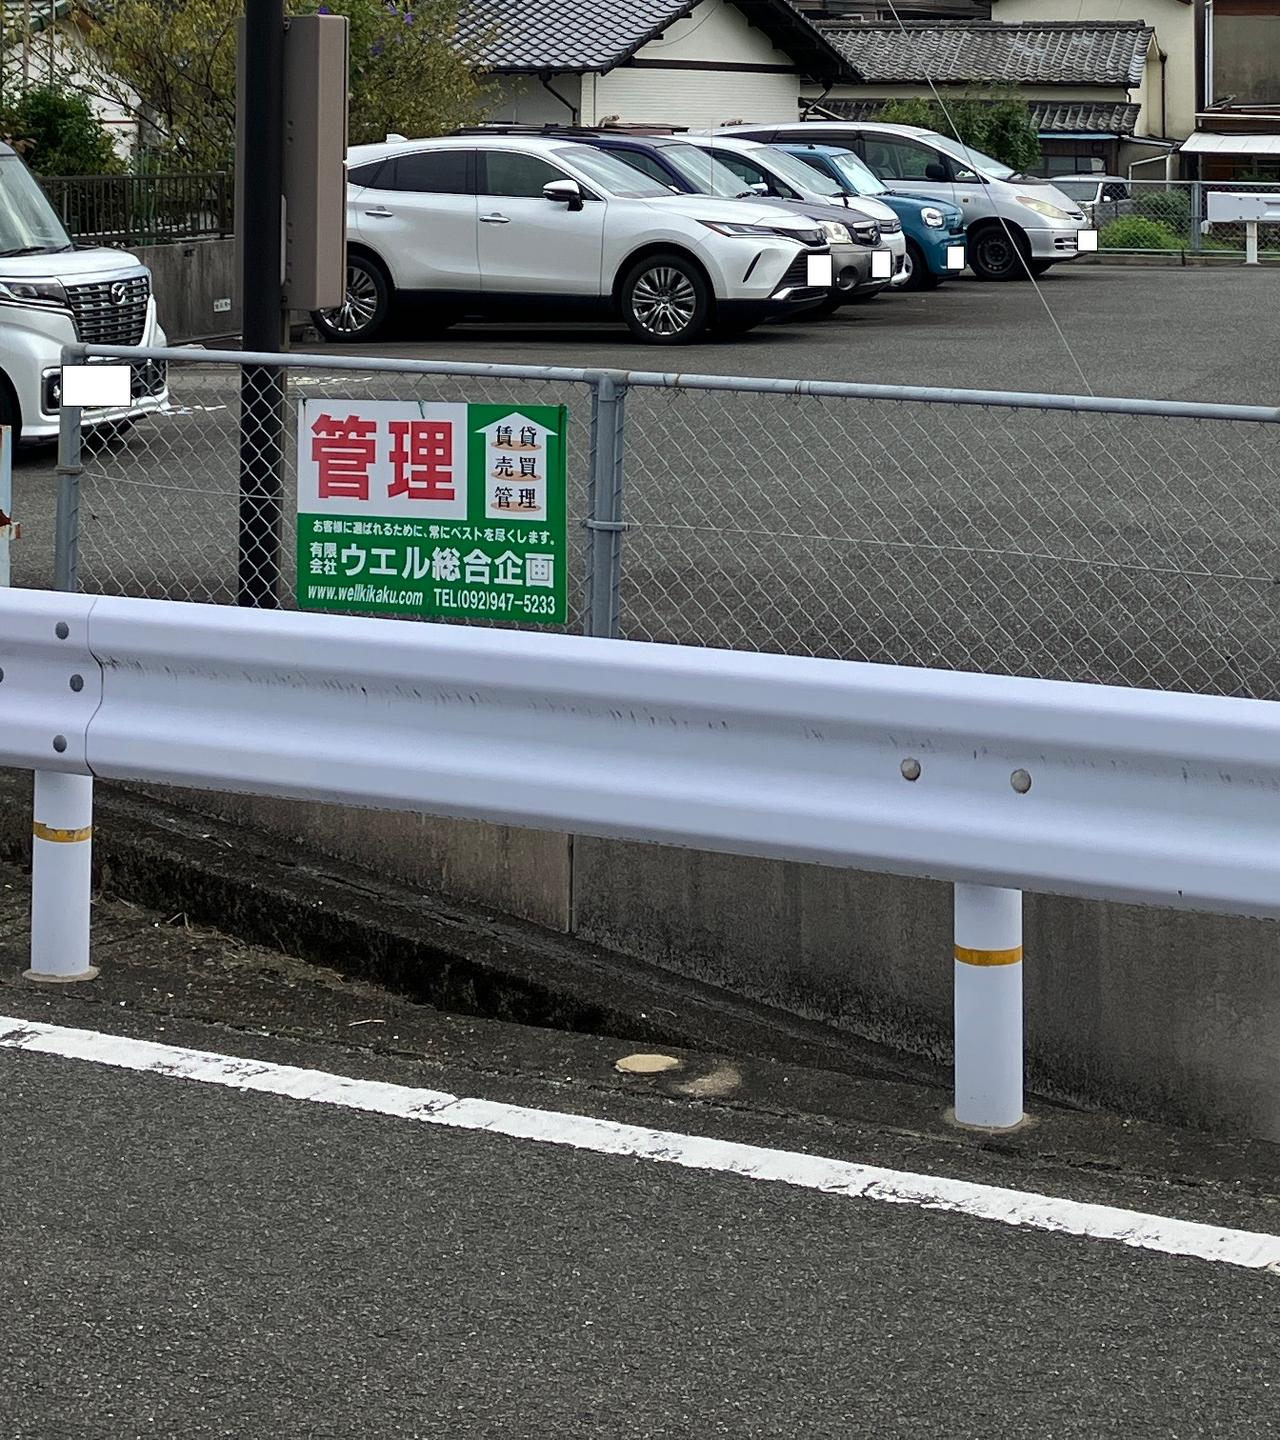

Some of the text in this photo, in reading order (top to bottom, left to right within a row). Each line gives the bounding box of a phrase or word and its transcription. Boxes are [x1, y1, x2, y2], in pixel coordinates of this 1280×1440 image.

[495, 425, 537, 448] 賃貸
[310, 413, 456, 501] 管理
[494, 455, 537, 479] 売買
[494, 485, 537, 509] 管理
[340, 542, 555, 589] ウエル総合企画
[307, 583, 556, 615] www.wellkikaku.com TEL(092)947-5233
